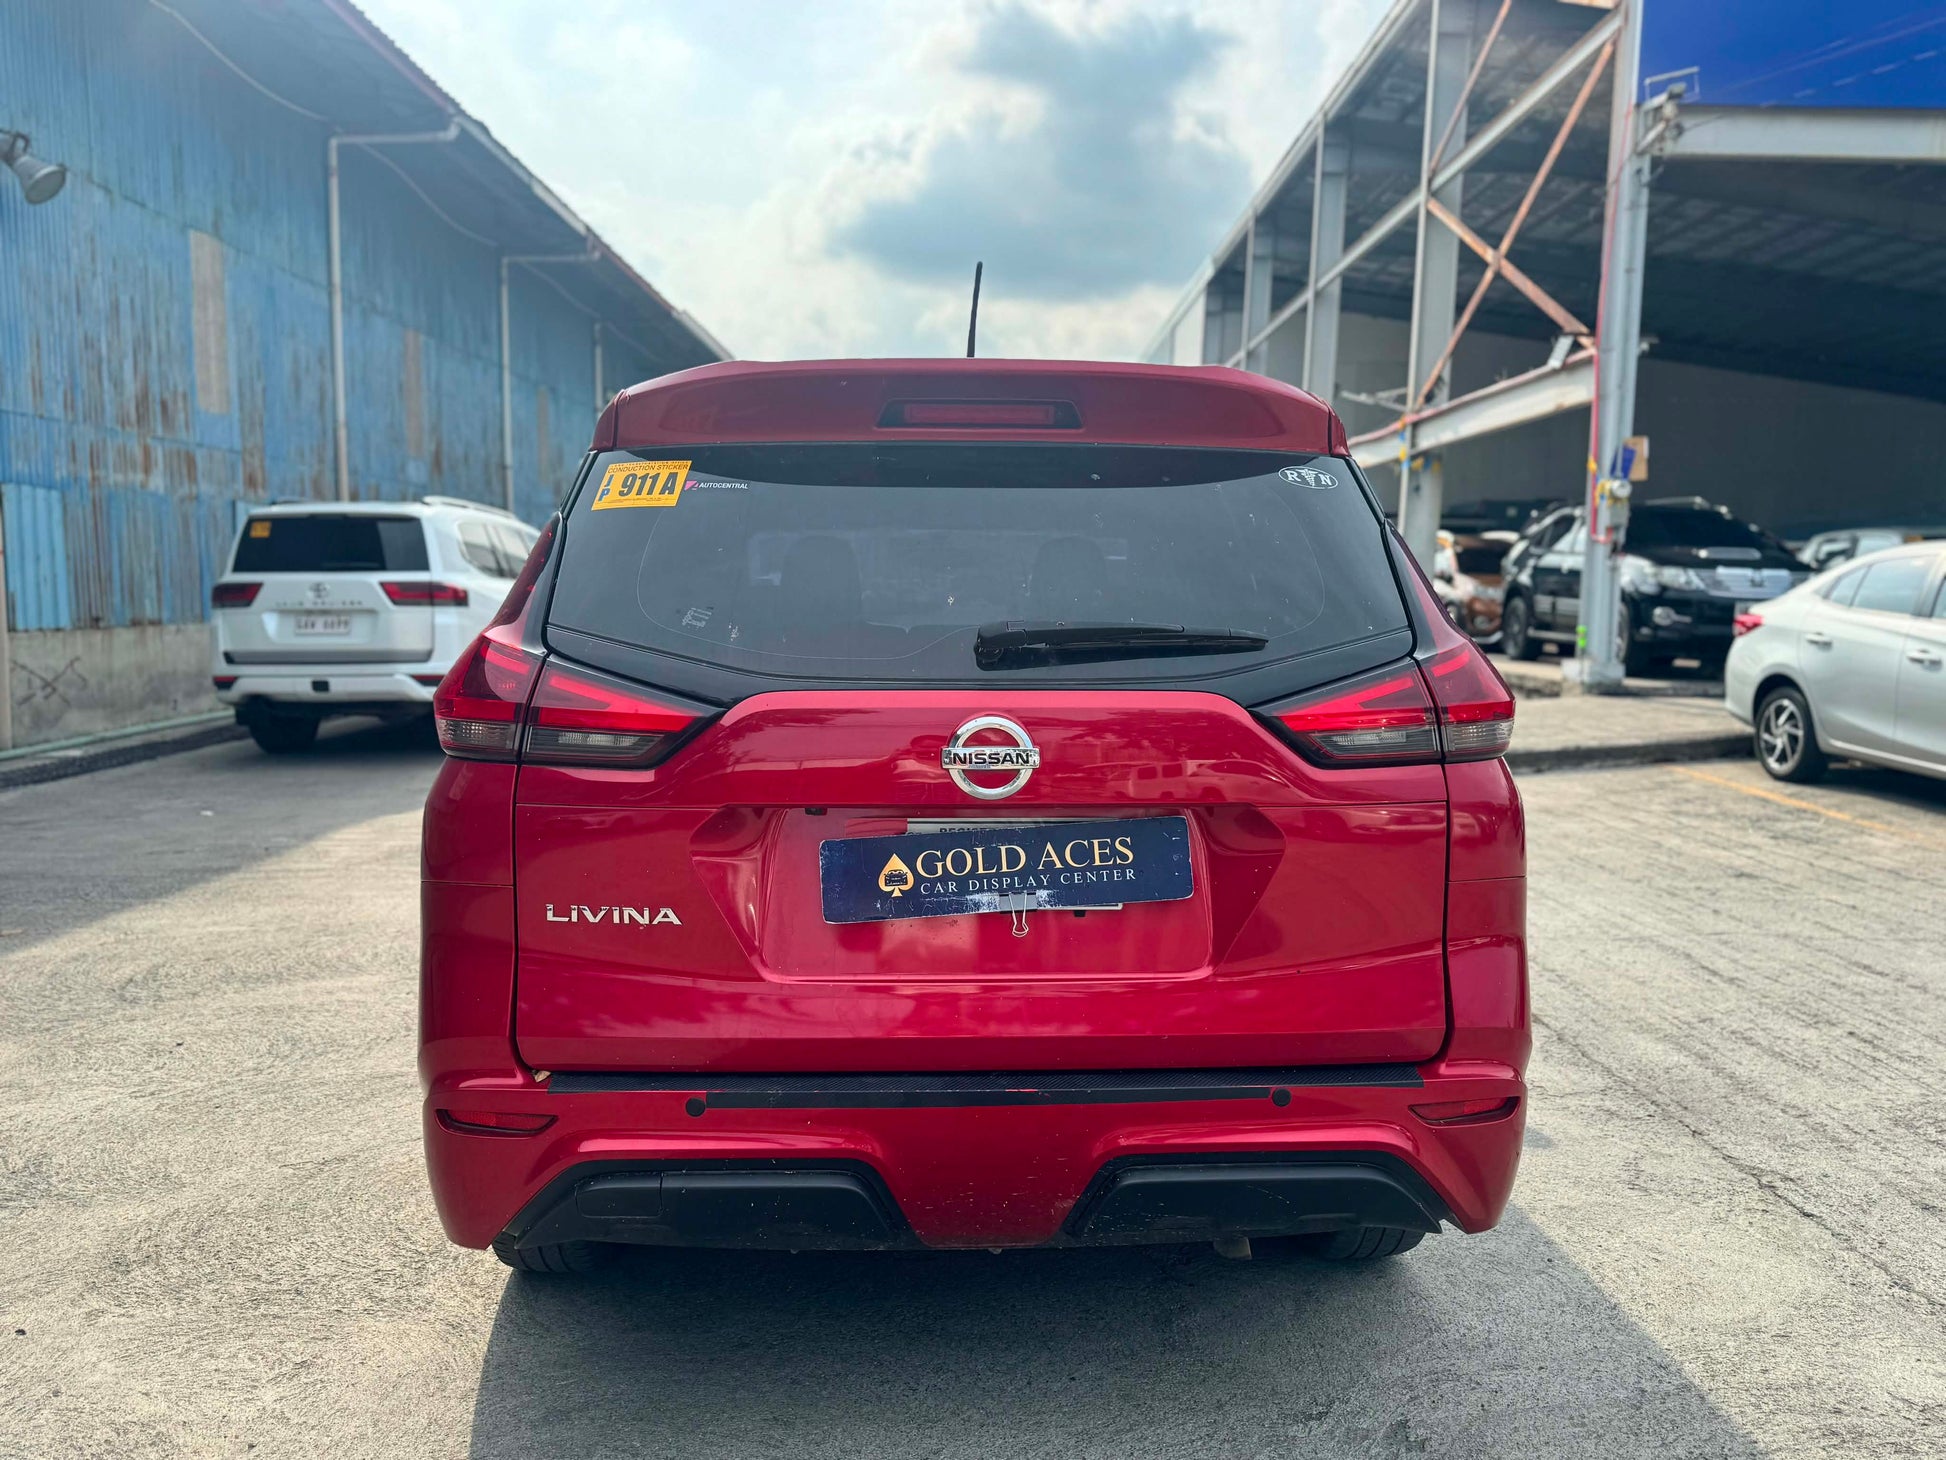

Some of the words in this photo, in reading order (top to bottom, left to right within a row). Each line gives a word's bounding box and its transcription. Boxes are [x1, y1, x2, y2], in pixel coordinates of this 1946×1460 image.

[607, 464, 656, 474] CONDUCTION
[698, 482, 749, 490] AUTOCENTRAL
[952, 752, 1030, 765] NISSAN
[915, 844, 1027, 878] GOLD
[1036, 836, 1134, 870] ACES
[920, 881, 958, 895] CAR
[968, 874, 1051, 891] DISPLAY
[1060, 868, 1136, 885] CENTER
[545, 903, 683, 926] LIVINA
